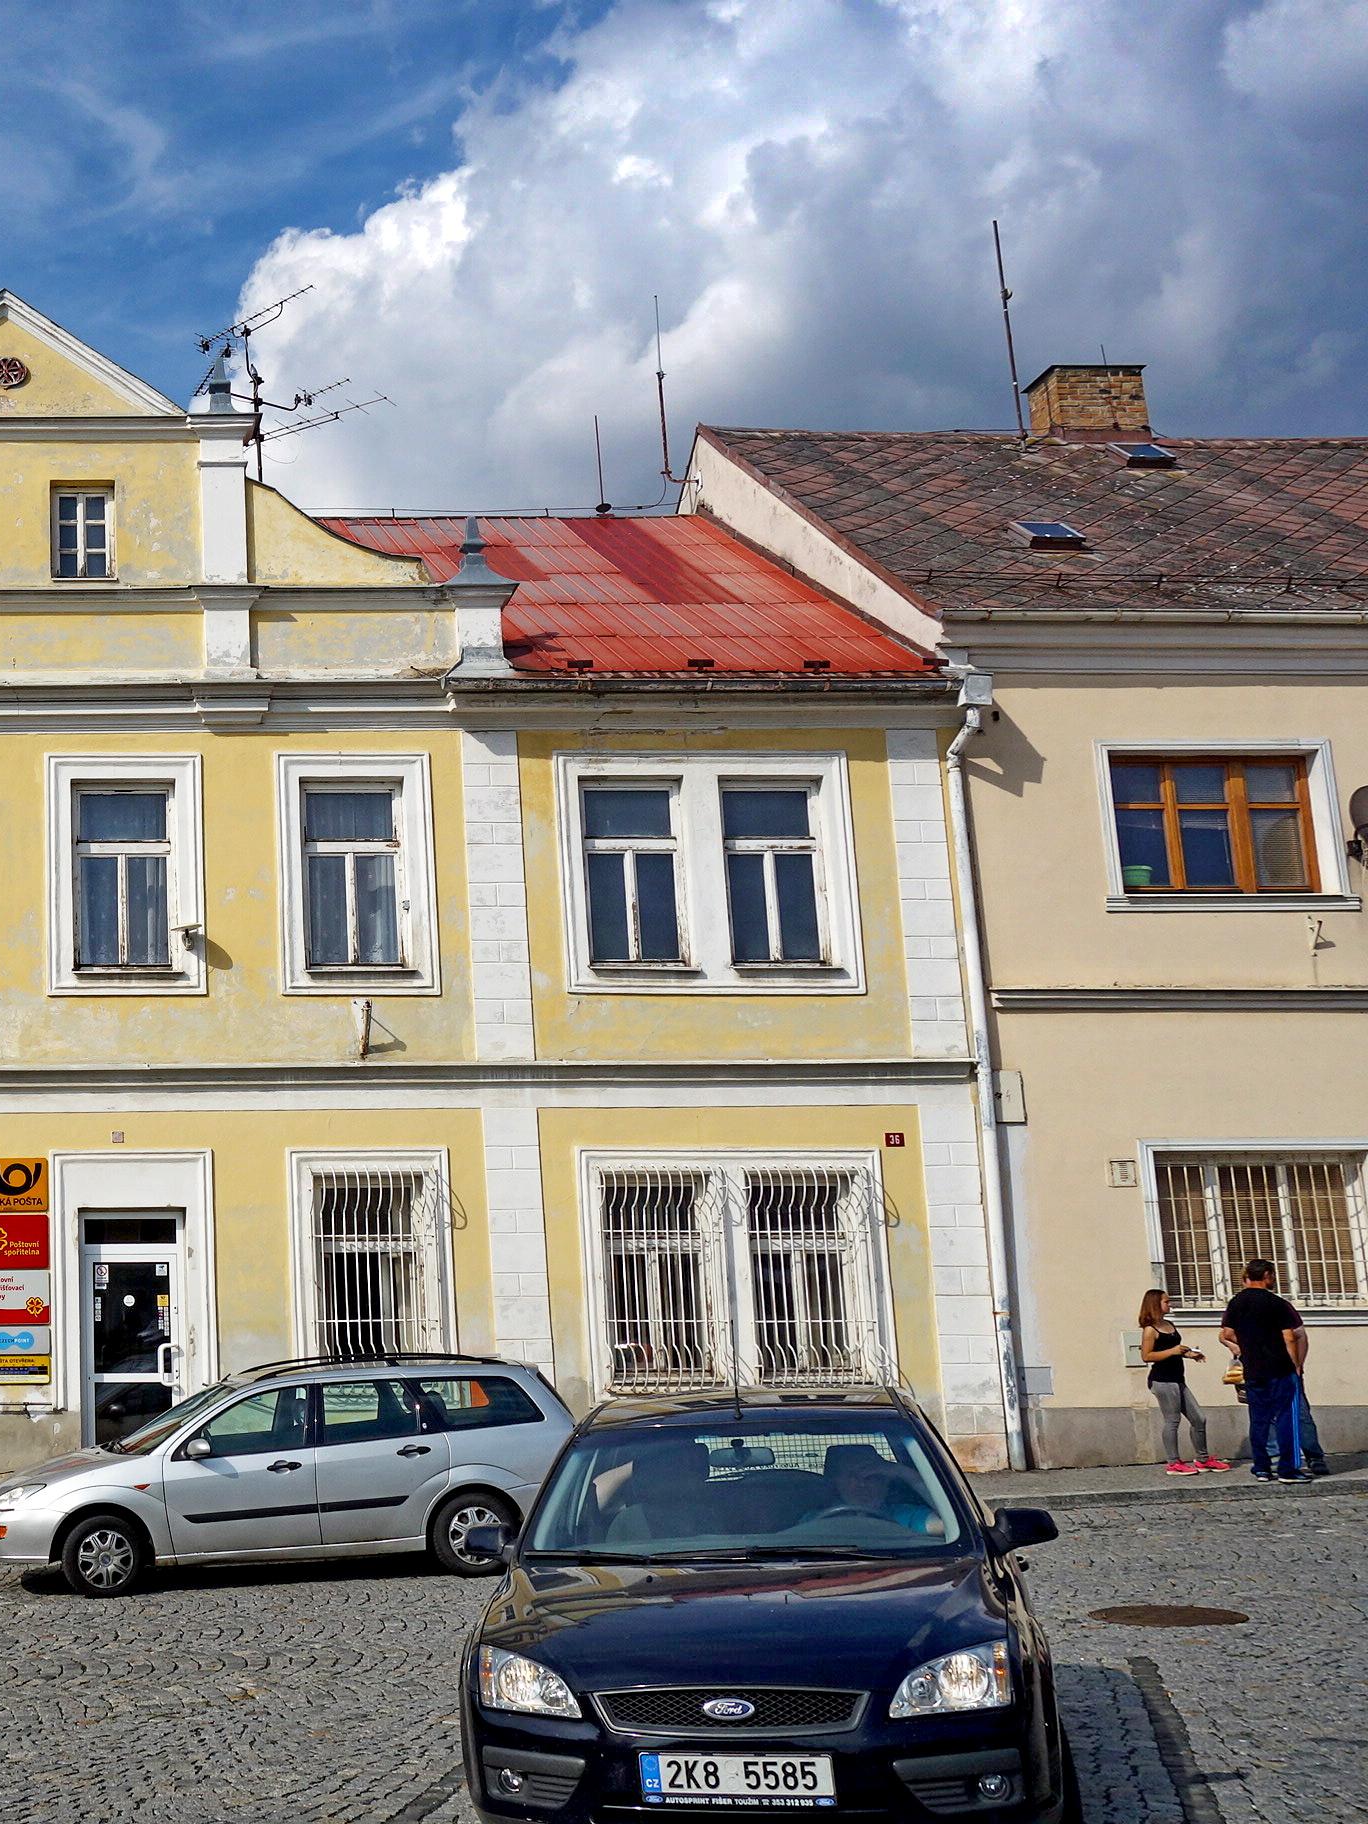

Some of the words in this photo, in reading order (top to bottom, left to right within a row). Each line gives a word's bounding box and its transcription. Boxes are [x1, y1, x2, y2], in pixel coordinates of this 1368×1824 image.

[889, 1134, 901, 1145] 36
[13, 1197, 43, 1206] POŠTA
[9, 1240, 40, 1248] Poštovní
[3, 1248, 40, 1257] spořitelna
[714, 1702, 743, 1715] Ford
[646, 1779, 661, 1788] CZ
[666, 1760, 720, 1789] 2K8
[743, 1761, 818, 1790] 5585
[665, 1796, 709, 1805] AUTOSPRINT
